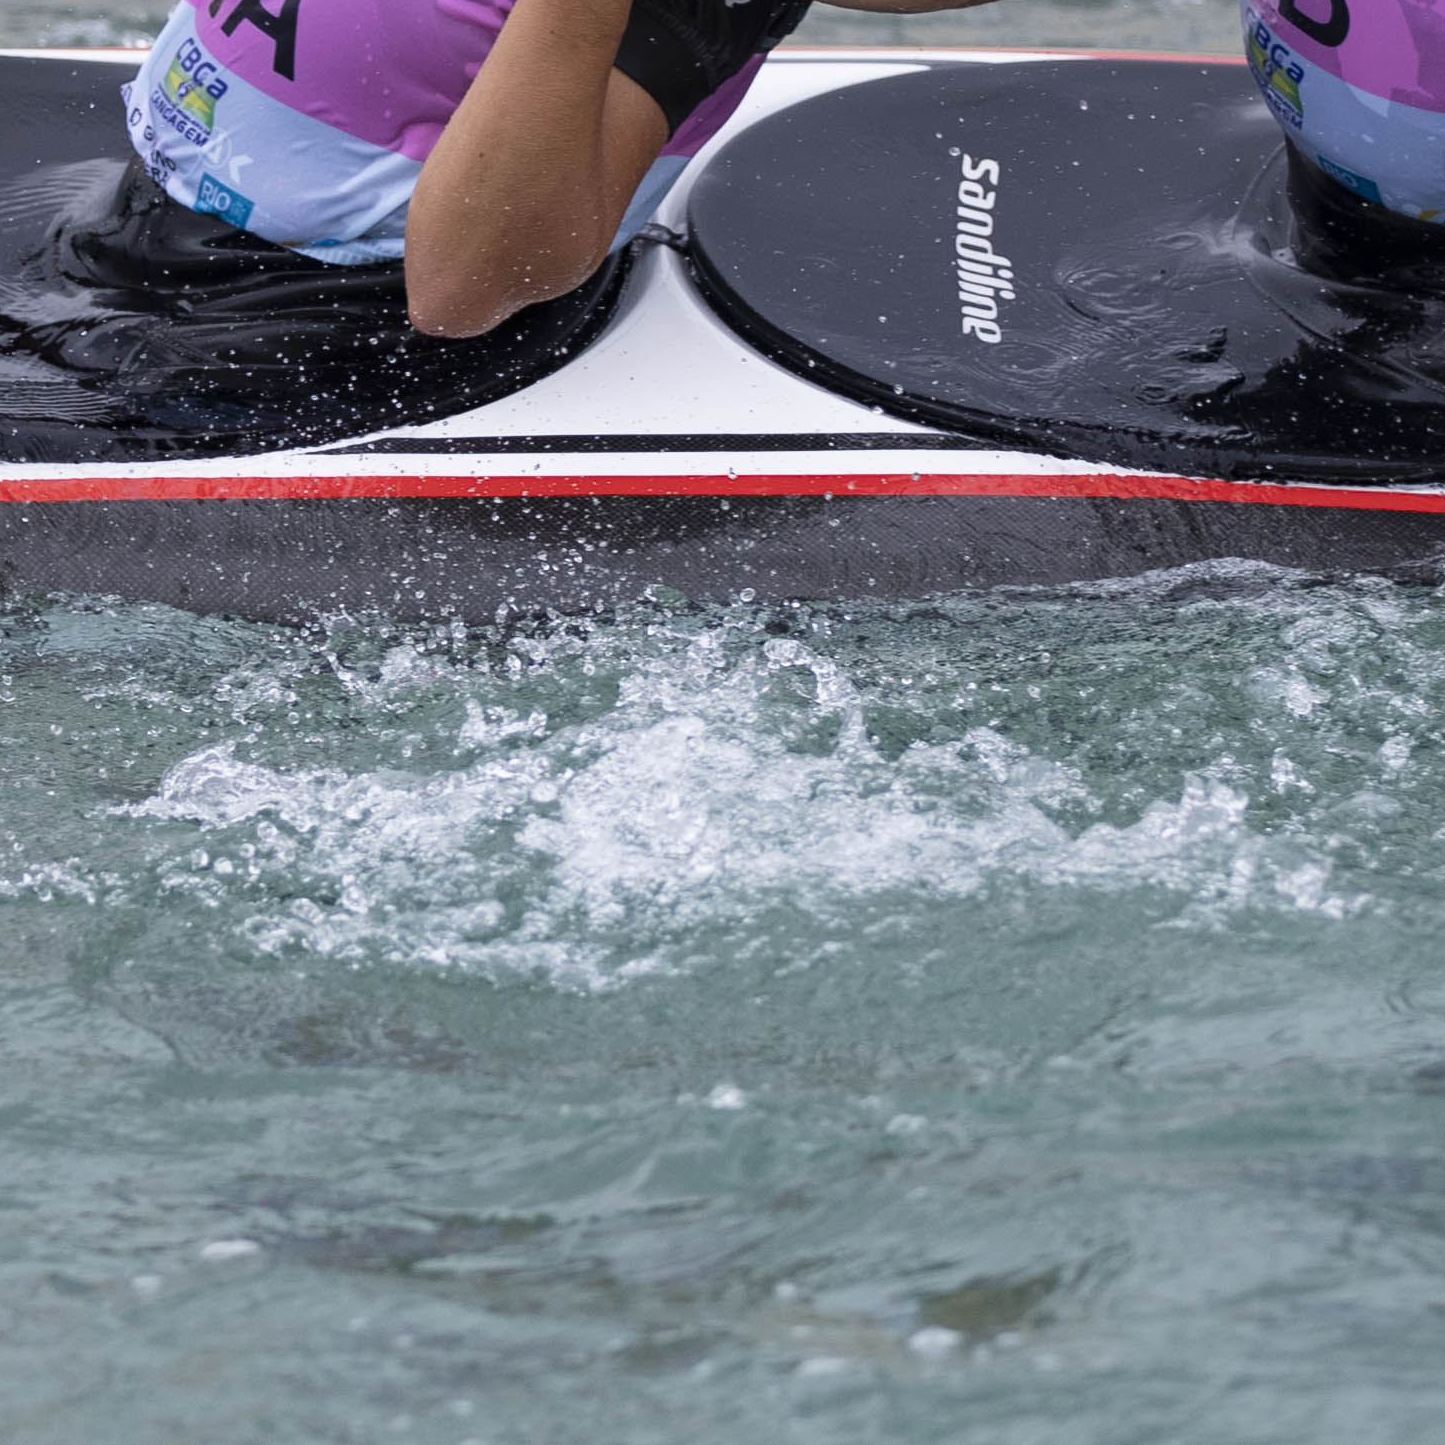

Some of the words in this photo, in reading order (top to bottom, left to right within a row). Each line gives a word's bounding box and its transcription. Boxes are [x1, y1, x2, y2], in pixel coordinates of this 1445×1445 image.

[176, 37, 228, 100] CBCa
[201, 181, 231, 212] RIO
[956, 153, 1016, 344] sandiline
